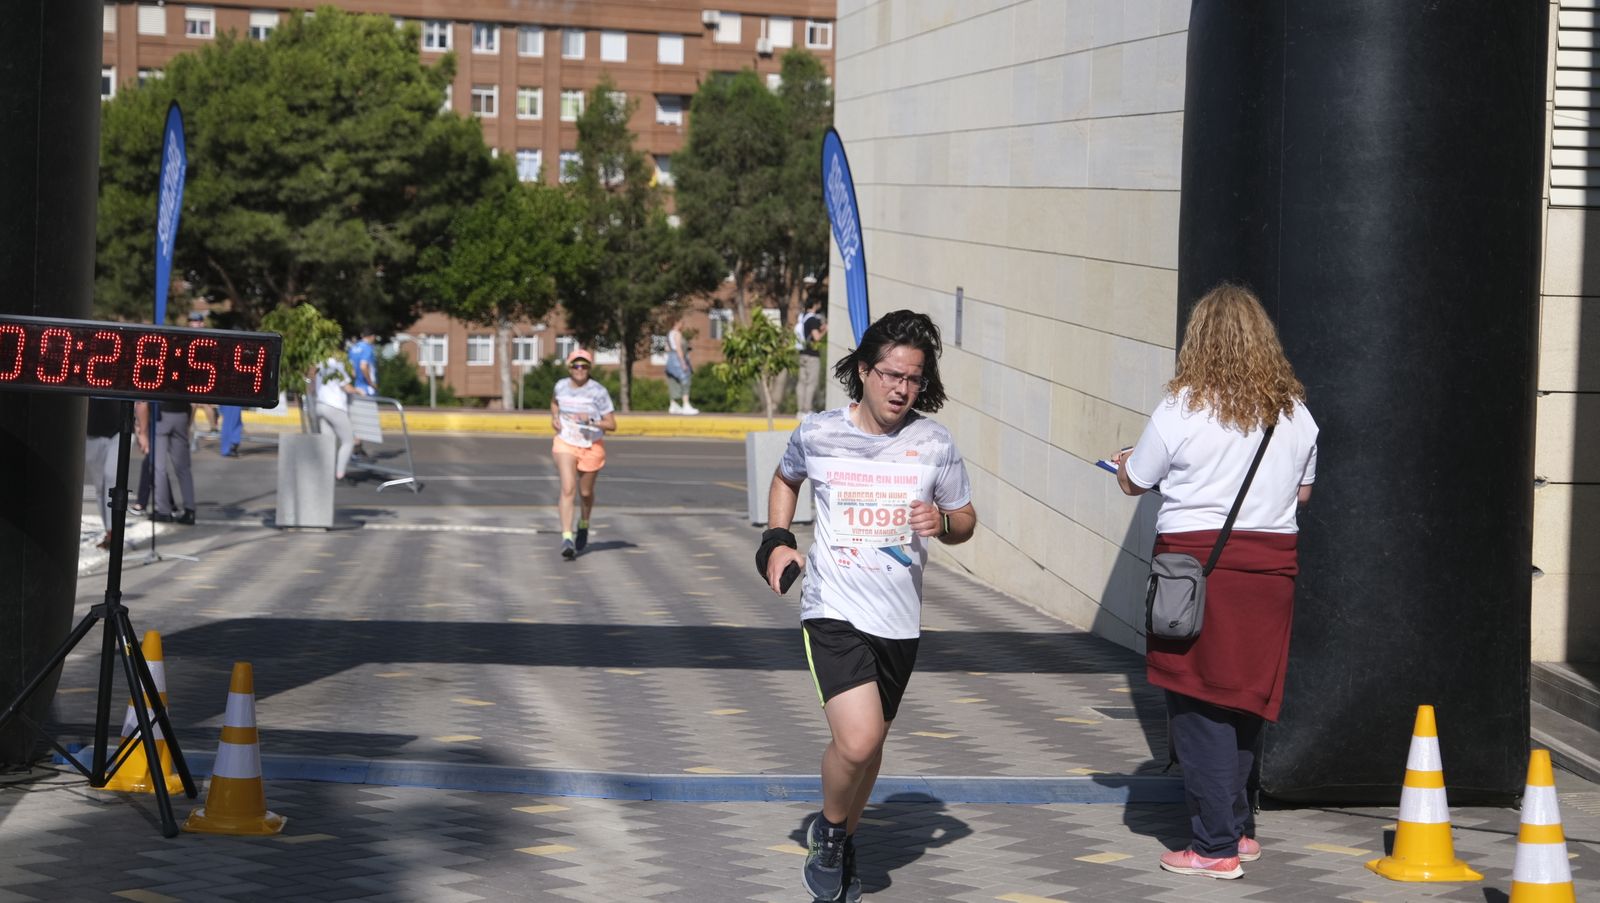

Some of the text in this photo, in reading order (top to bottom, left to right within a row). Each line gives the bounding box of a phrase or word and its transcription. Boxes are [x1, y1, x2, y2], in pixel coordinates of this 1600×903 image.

[0, 323, 266, 394] 00:28:54
[834, 471, 874, 483] CARRERA
[876, 474, 892, 484] SIN
[894, 475, 918, 485] HUMO
[875, 491, 887, 499] SIN
[843, 507, 907, 527] 1098
